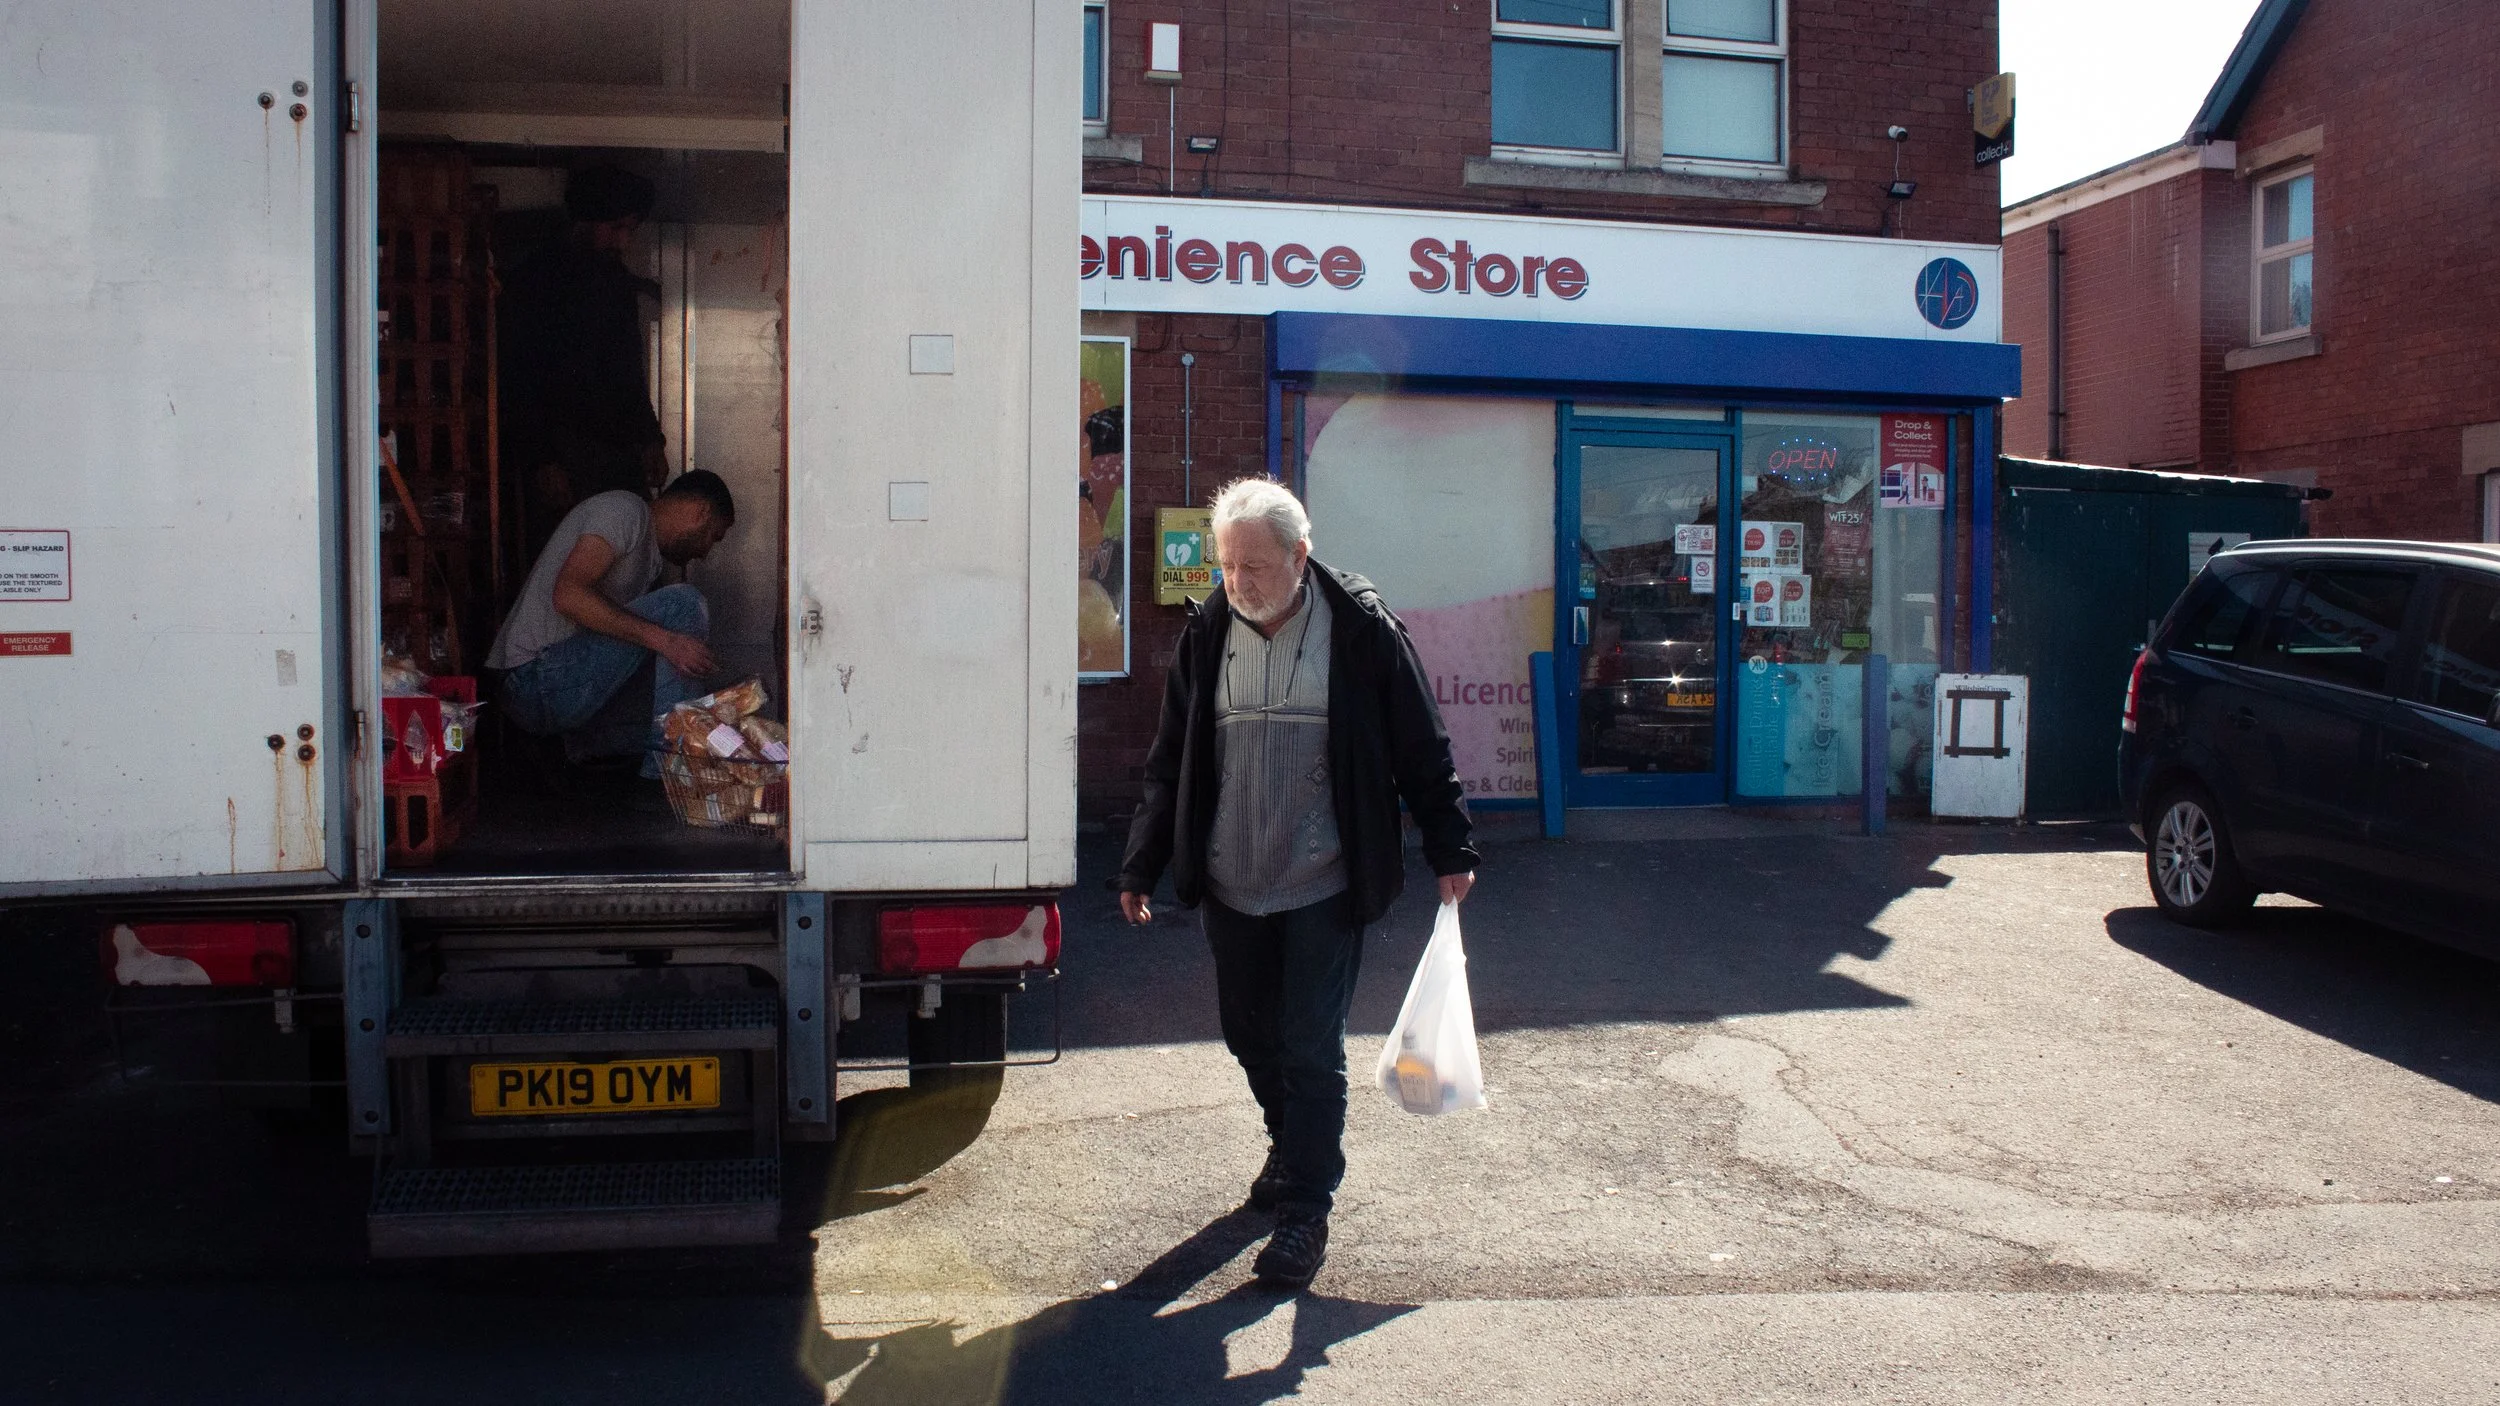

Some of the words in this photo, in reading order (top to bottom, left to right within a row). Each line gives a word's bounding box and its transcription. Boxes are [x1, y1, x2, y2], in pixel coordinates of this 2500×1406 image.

[1409, 237, 1589, 300] Store
[1895, 420, 1921, 430] Drop
[1924, 422, 1932, 430] &
[1894, 431, 1932, 440] Collect
[1768, 450, 1837, 469] OPEN
[1163, 572, 1184, 582] DIAL
[1187, 572, 1209, 582] 999
[1814, 672, 1832, 747] Cream
[1813, 756, 1830, 786] Ice
[1480, 777, 1491, 792] &
[498, 1068, 594, 1107] PK19
[609, 1065, 692, 1104] OYM
